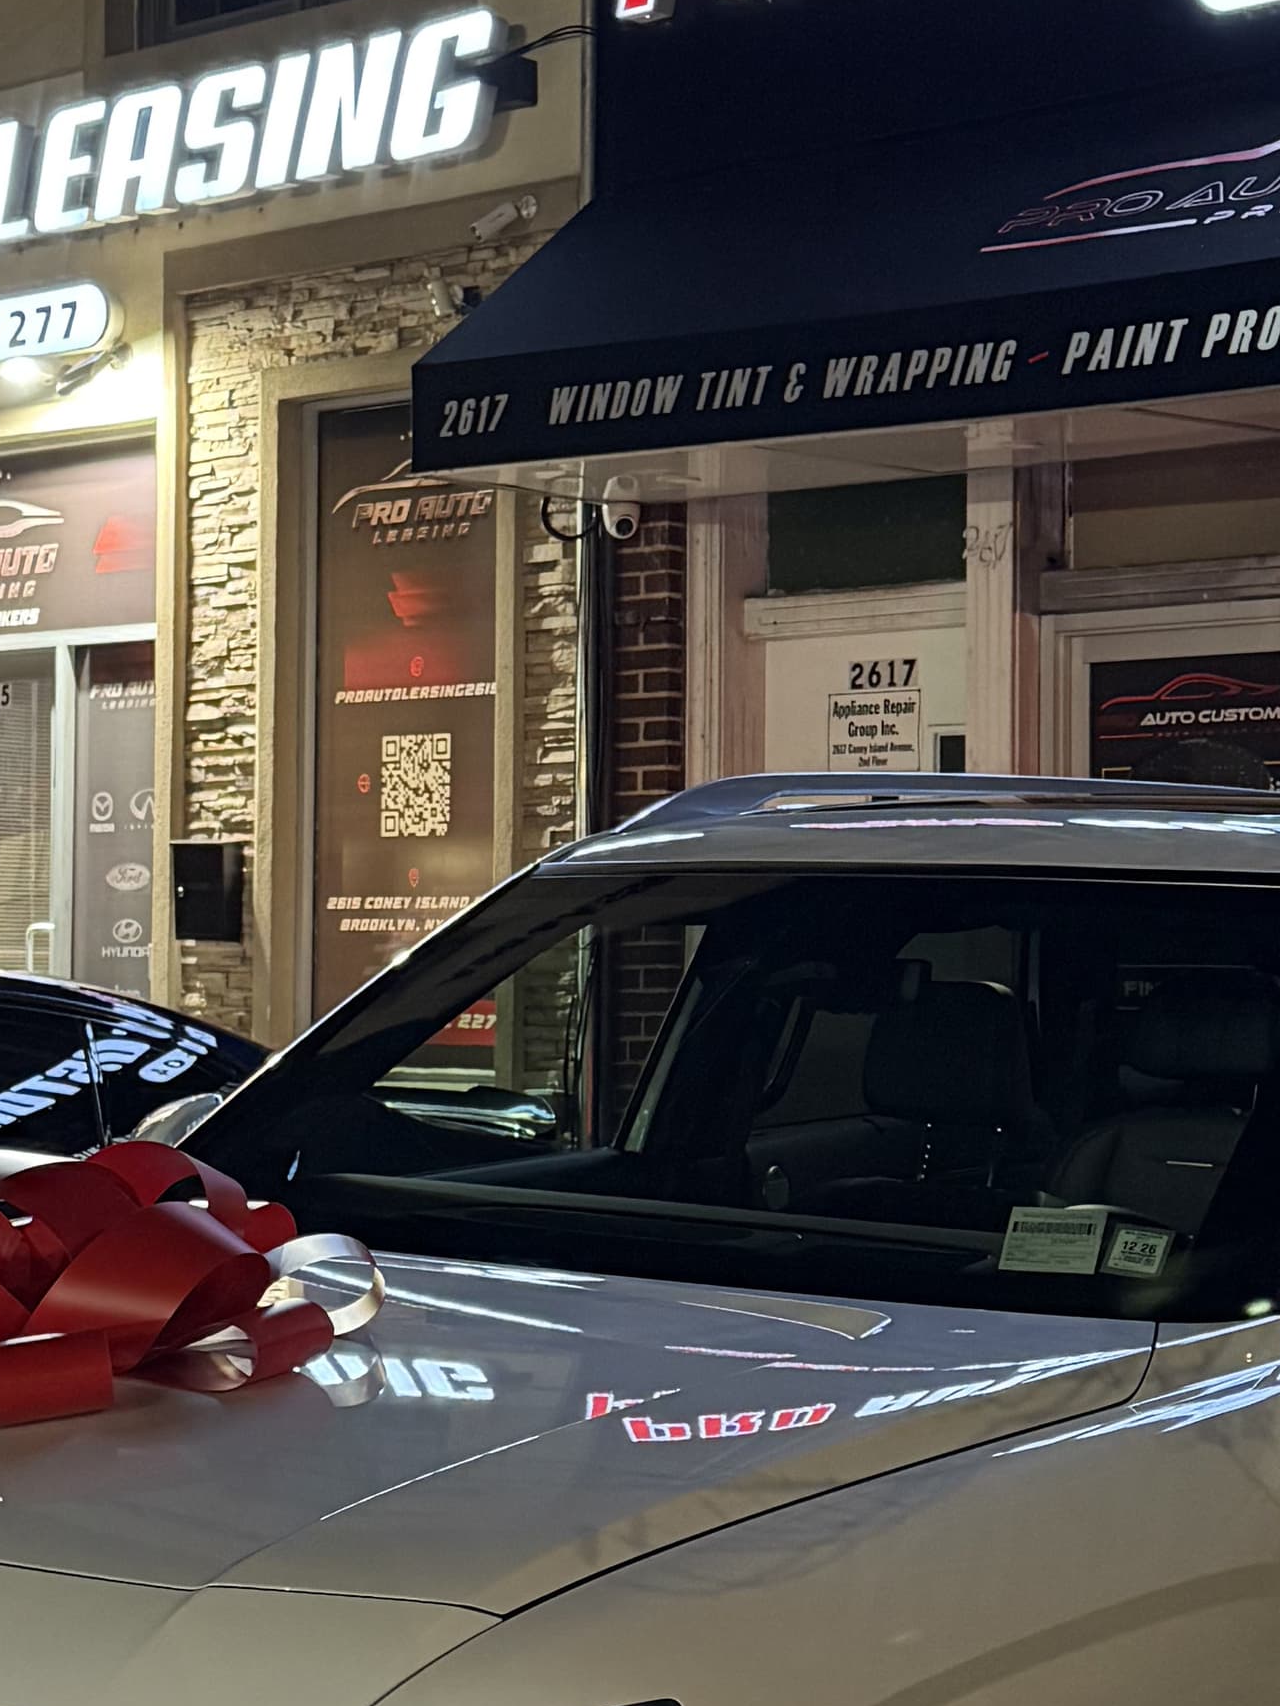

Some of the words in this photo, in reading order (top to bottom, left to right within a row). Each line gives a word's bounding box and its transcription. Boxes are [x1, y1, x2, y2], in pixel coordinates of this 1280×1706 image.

[998, 190, 1164, 234] PRO
[439, 394, 508, 438] 2617
[548, 374, 683, 426] WINDOW
[695, 365, 772, 412] TINT
[784, 362, 807, 403] &
[823, 339, 1018, 400] WRAPPING
[1061, 318, 1189, 376] PAINT
[352, 499, 411, 528] PRO
[415, 489, 494, 522] AUTO
[373, 522, 471, 544] LEASING
[851, 659, 917, 690] 2617
[832, 701, 880, 719] Appliance
[883, 696, 916, 717] Repair
[1140, 711, 1196, 727] AUTO
[848, 721, 878, 739] Group
[881, 720, 899, 736] Inc.
[326, 896, 361, 910] 2615
[364, 896, 411, 910] CONEY
[415, 895, 470, 909] ISLAND
